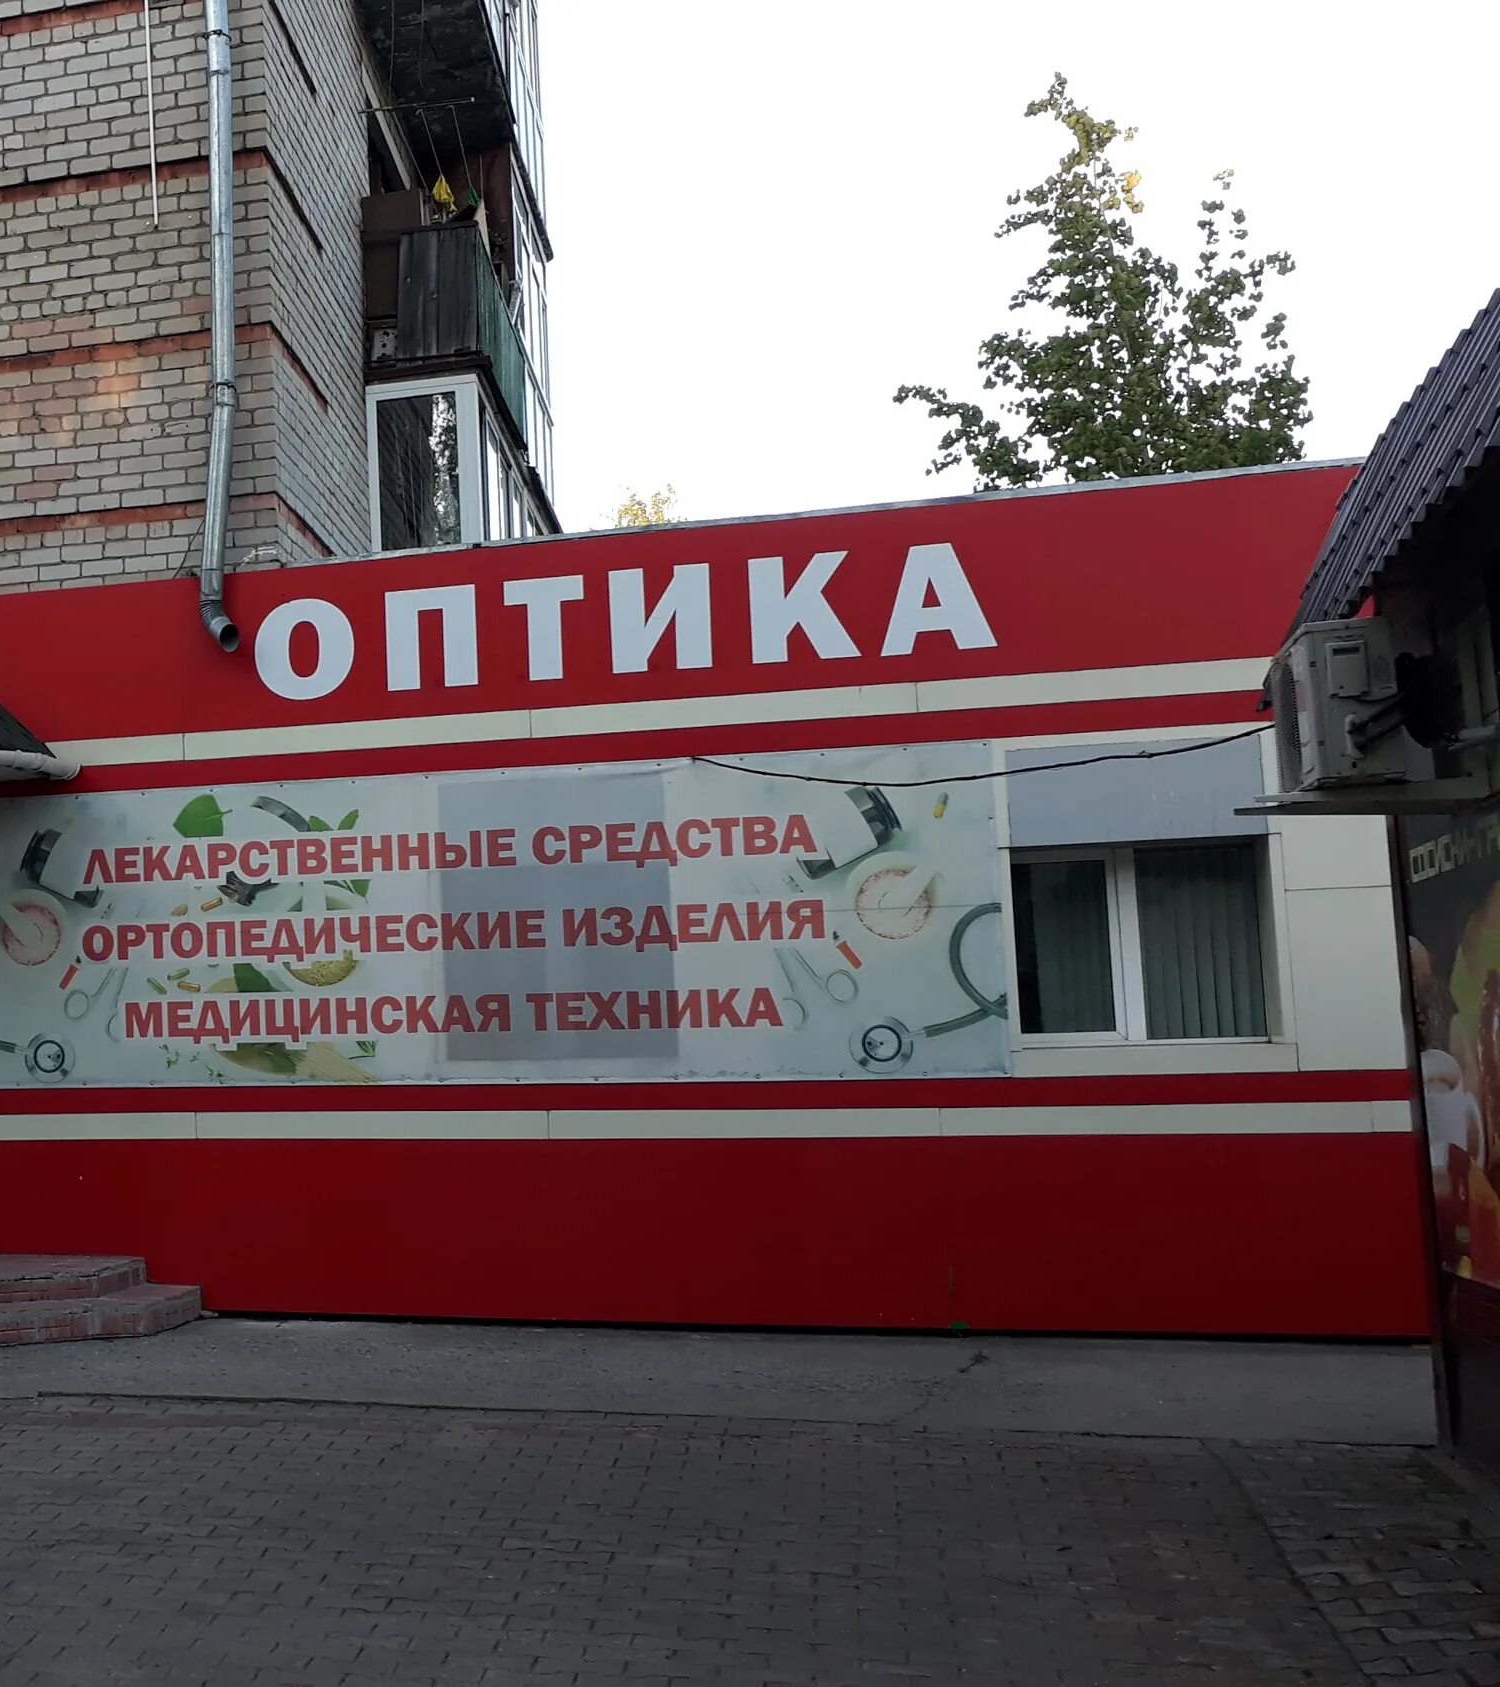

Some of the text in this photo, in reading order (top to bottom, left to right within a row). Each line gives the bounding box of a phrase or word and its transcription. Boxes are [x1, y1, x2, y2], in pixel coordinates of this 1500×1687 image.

[254, 542, 999, 701] ОПТИКА
[83, 813, 818, 886] ЛЕКАРСТВЕННЫЕ СРЕДСТВА
[82, 899, 826, 964] ОРТОПЕДИЧЕСКИЕ ИЗДЕЛИЯ
[124, 987, 784, 1043] МЕДИЦИНСКАЯ ТЕХНИКА
